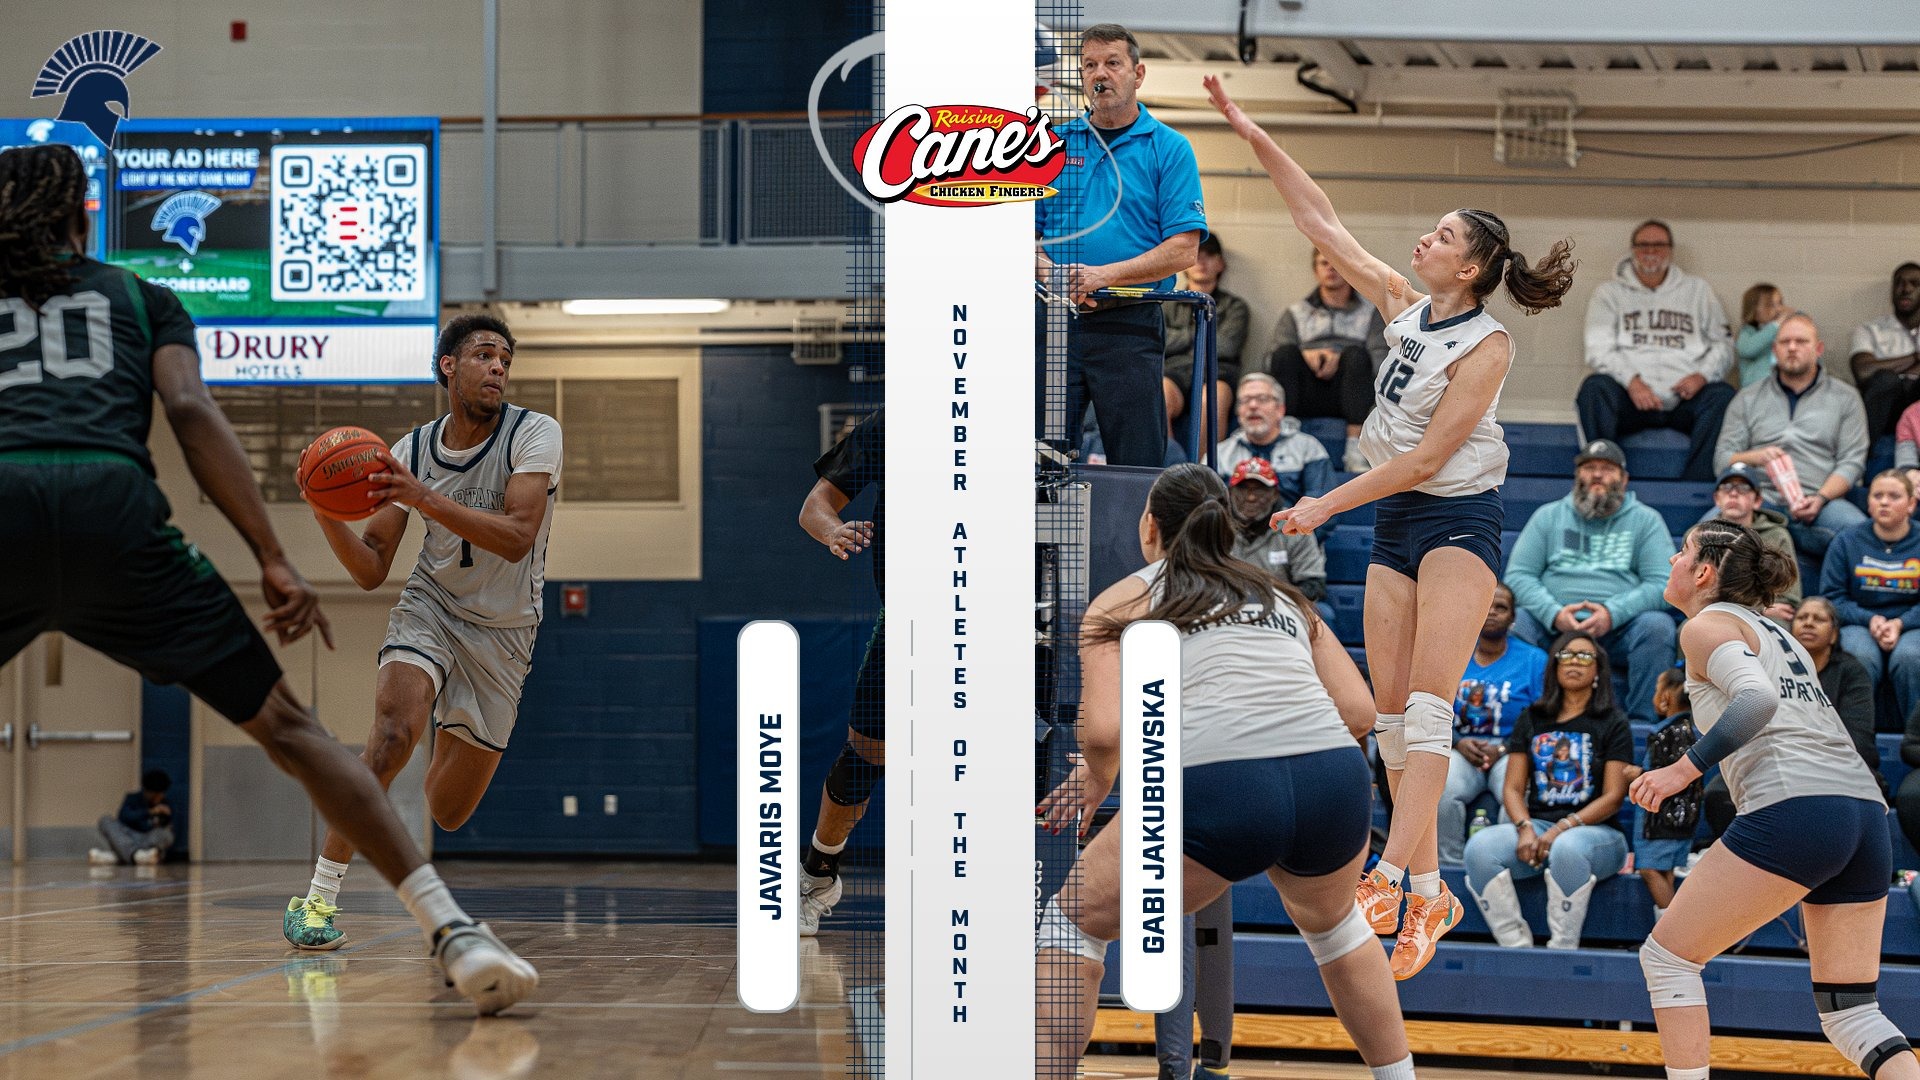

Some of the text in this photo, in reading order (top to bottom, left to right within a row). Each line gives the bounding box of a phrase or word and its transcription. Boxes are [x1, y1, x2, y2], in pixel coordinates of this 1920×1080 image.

[112, 148, 171, 169] YOUR
[172, 148, 203, 168] AD
[204, 148, 260, 168] HERE
[1649, 309, 1694, 334] LOUIS
[0, 290, 114, 391] 20
[213, 330, 330, 360] DRURY
[235, 364, 302, 377] HOTELS
[1378, 357, 1415, 405] 12
[321, 446, 380, 481] PALDING
